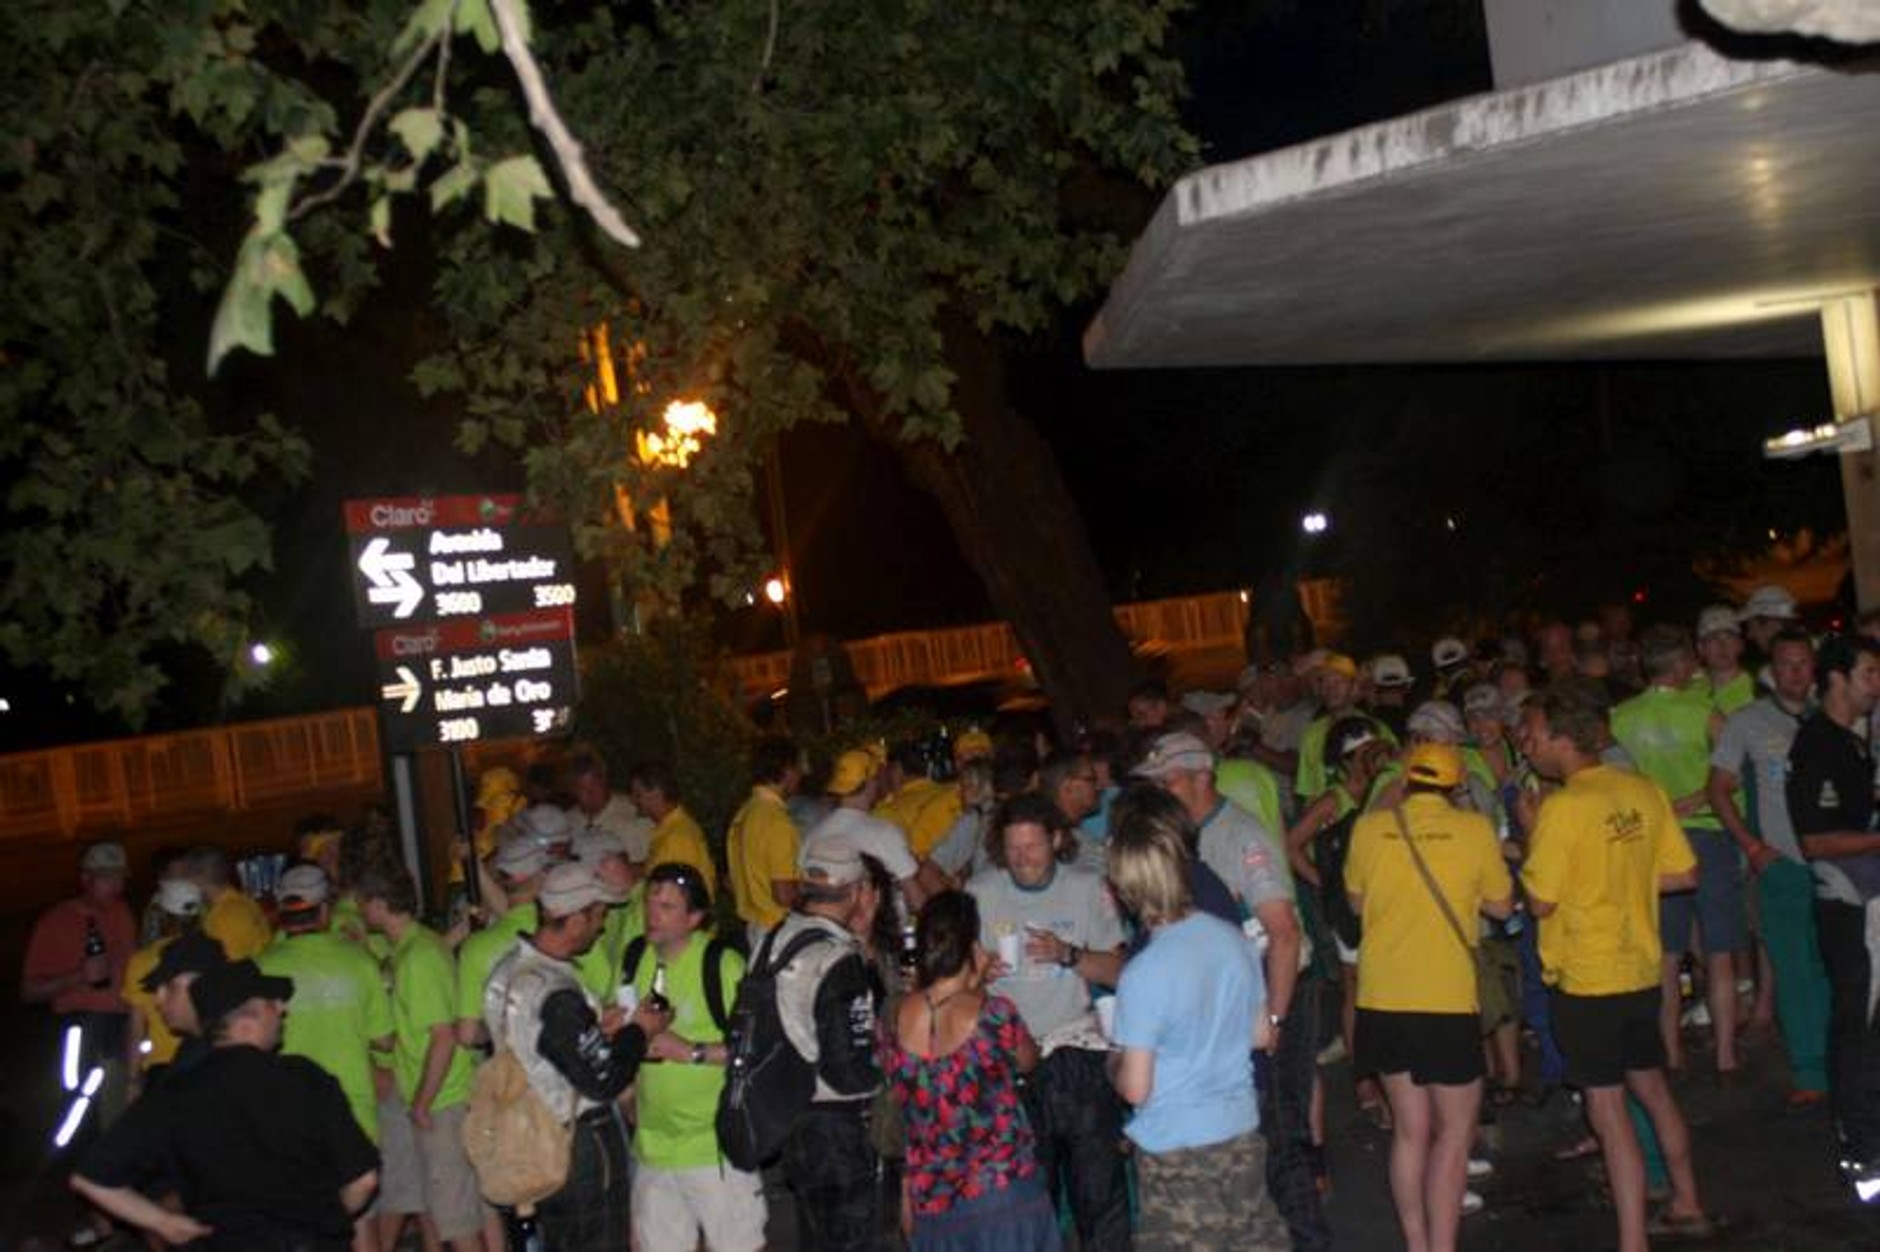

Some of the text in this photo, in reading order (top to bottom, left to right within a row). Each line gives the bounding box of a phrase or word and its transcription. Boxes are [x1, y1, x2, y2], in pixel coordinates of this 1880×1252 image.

[369, 503, 431, 528] Claro
[431, 556, 555, 585] Del Libertador
[392, 633, 436, 655] Claro
[451, 656, 496, 678] Justo
[499, 648, 551, 672] Santa
[487, 683, 511, 705] de
[515, 679, 551, 702] Oro
